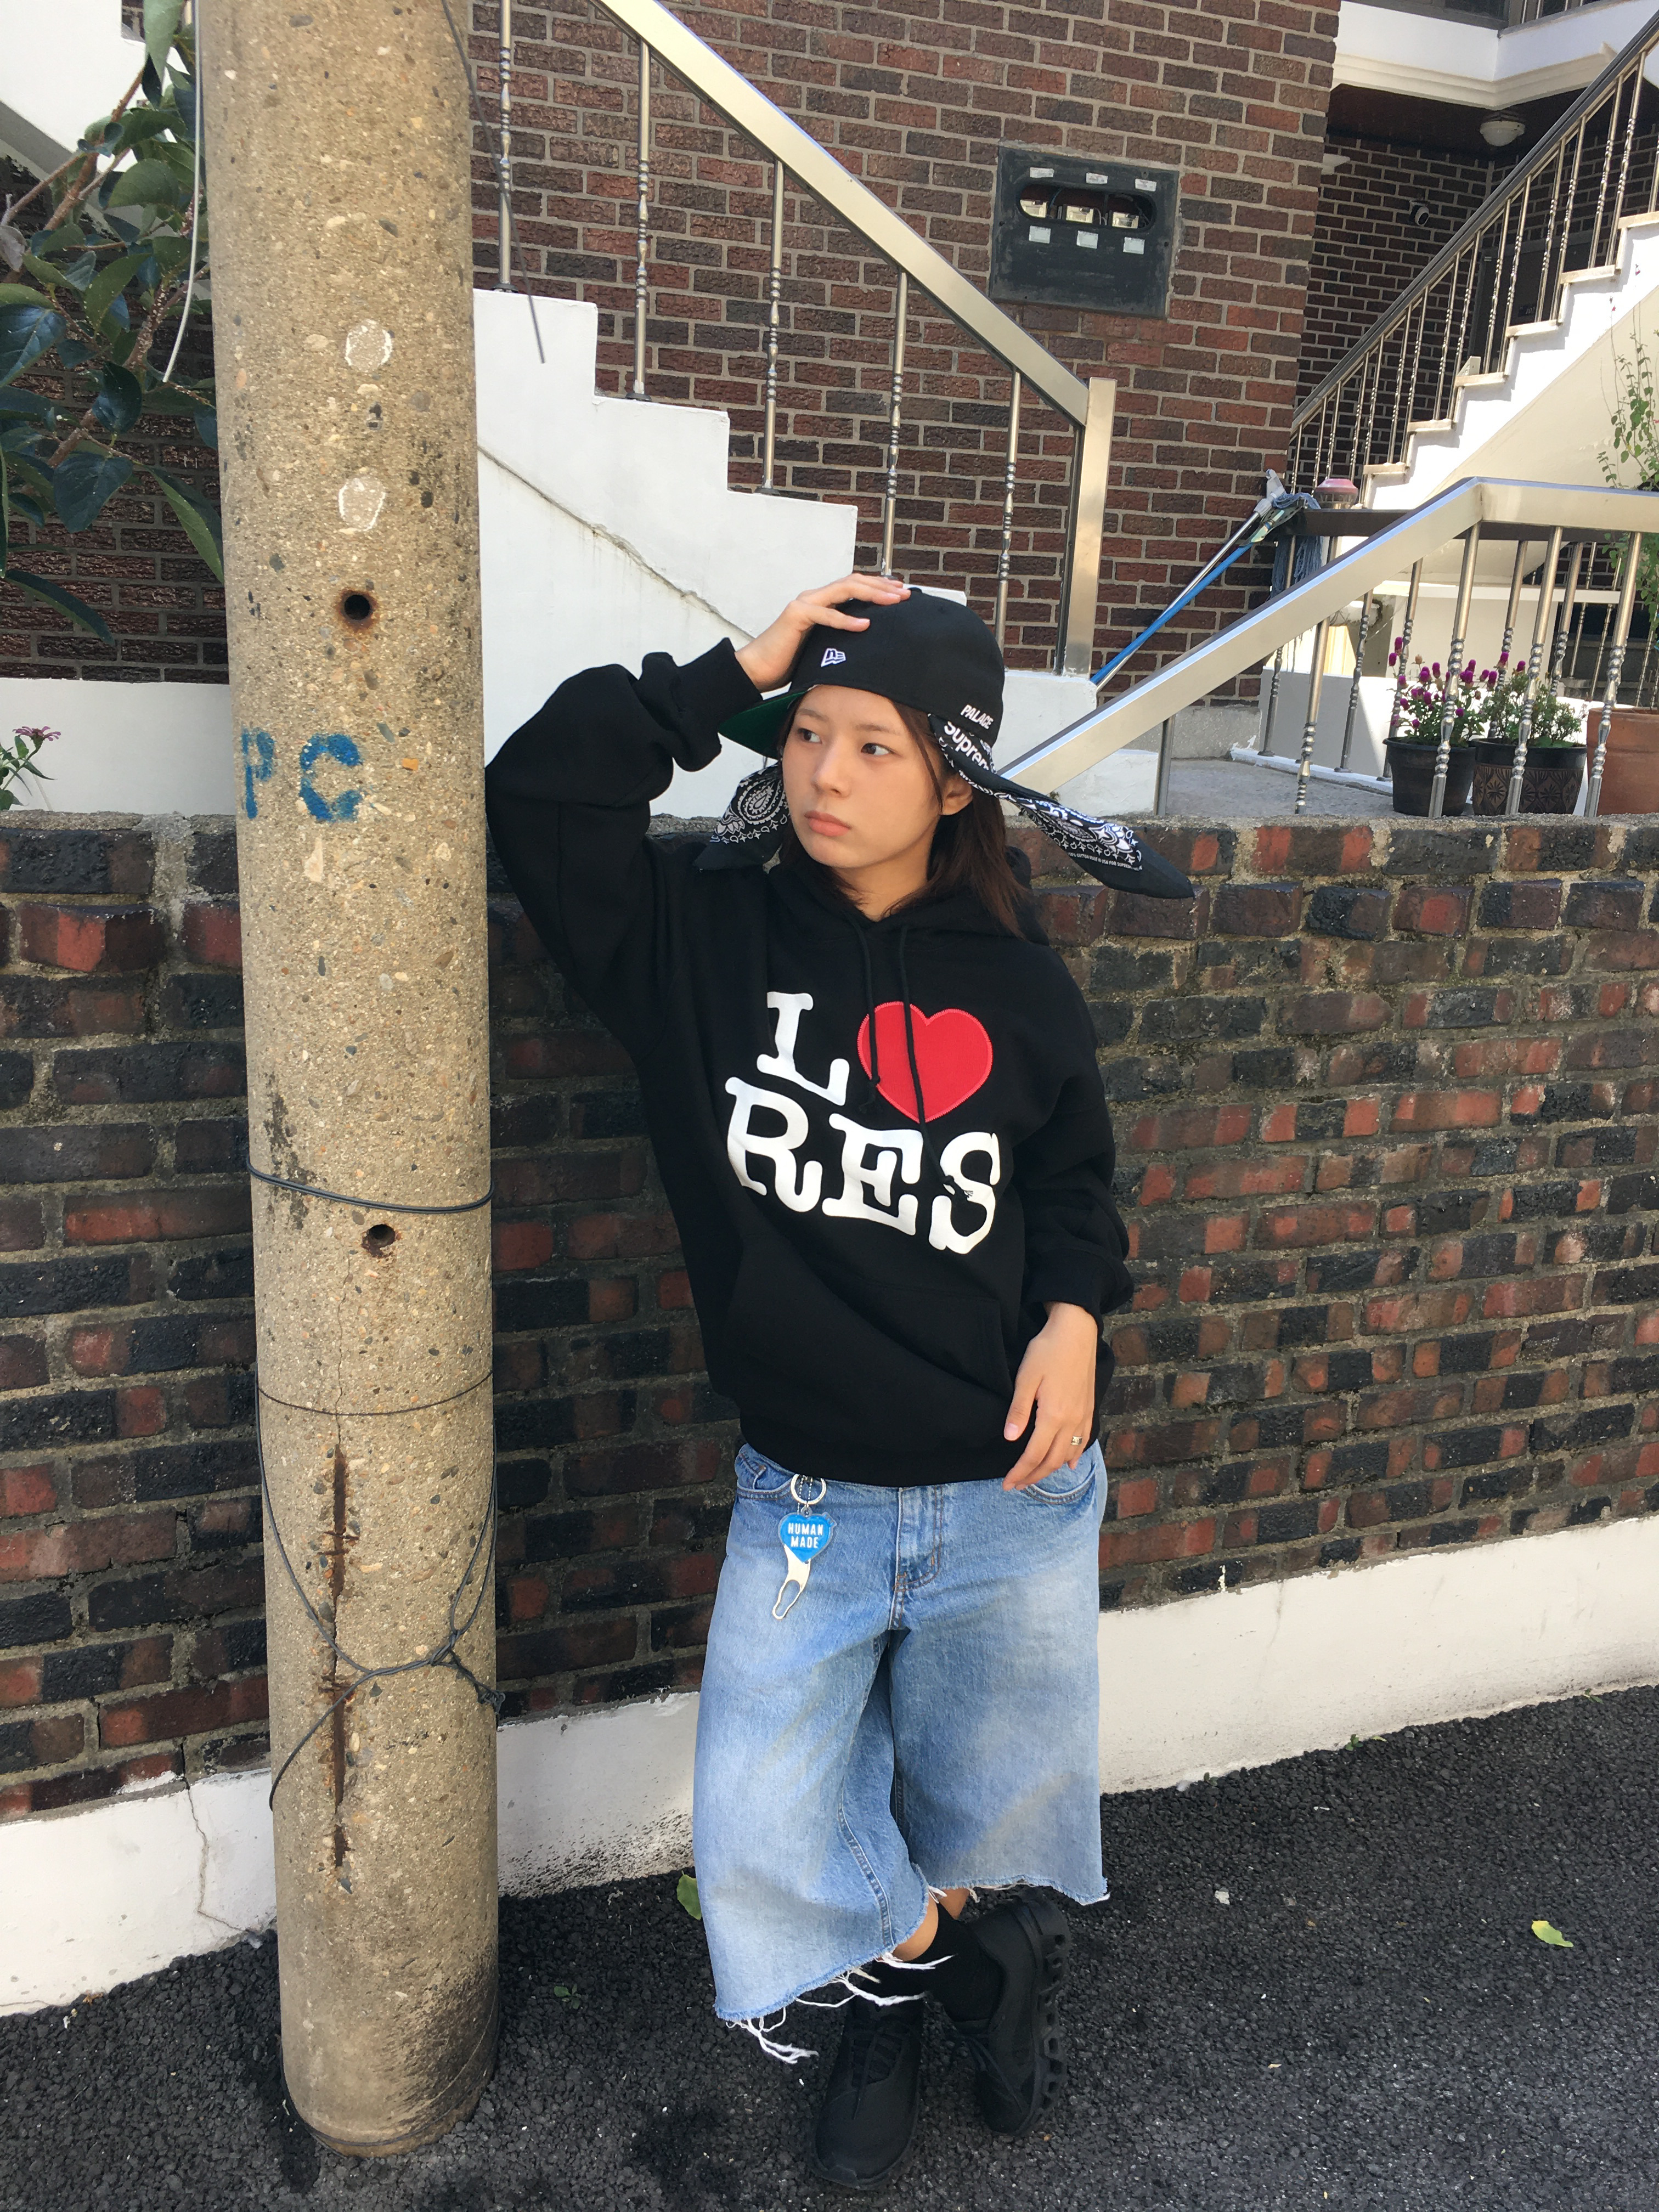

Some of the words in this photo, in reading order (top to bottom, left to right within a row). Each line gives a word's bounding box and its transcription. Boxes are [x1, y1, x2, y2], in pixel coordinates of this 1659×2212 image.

[960, 704, 994, 730] PALACE
[944, 721, 989, 771] Suprem
[725, 1076, 1000, 1255] RES
[788, 1522, 823, 1536] HUMAN
[791, 1536, 819, 1549] MADE
